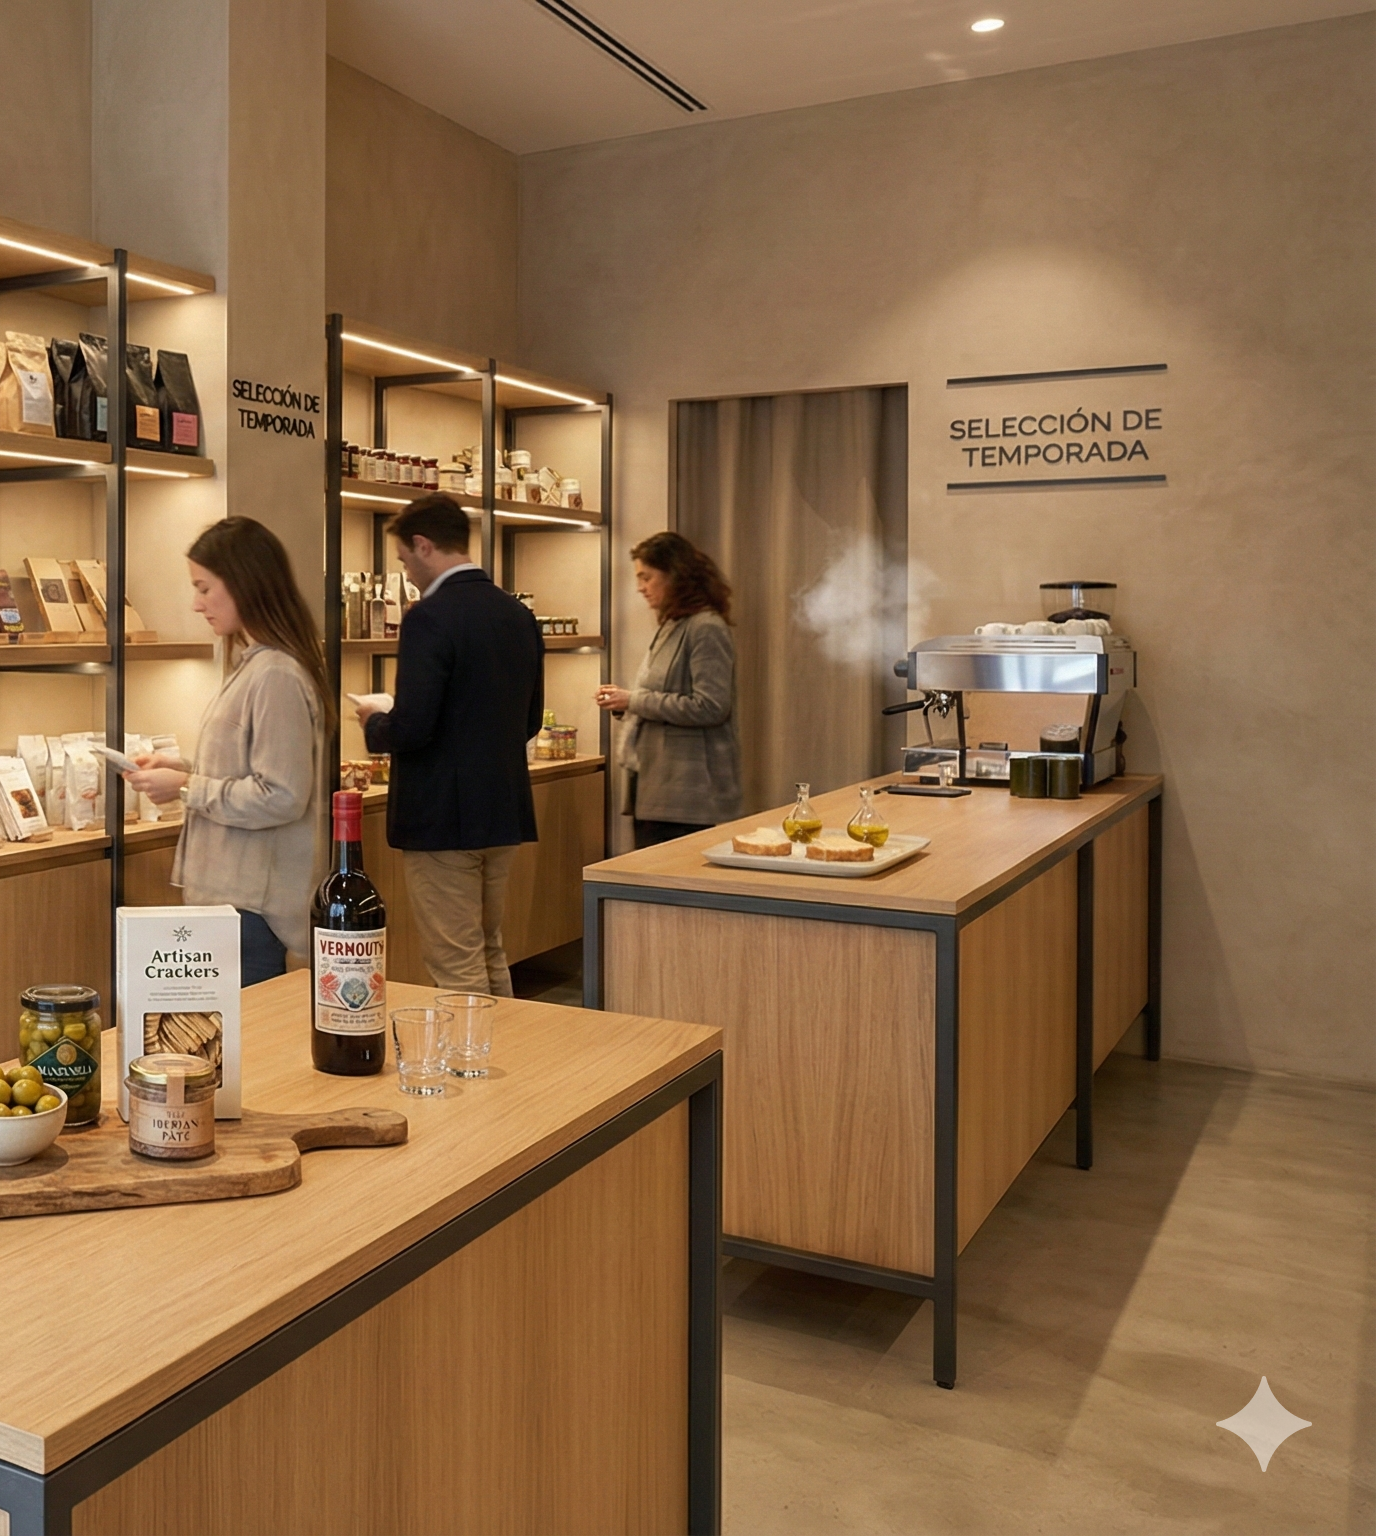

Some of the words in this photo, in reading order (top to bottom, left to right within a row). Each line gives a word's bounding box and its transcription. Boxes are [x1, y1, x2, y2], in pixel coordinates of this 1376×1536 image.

[232, 379, 301, 411] SELECCIÓN
[304, 393, 320, 413] DE
[237, 408, 316, 439] TEMPORADA
[949, 407, 1112, 440] SELECCIÓN
[1122, 408, 1163, 431] DE
[961, 439, 1150, 467] TEMPORADA
[151, 948, 212, 964] Artisan
[144, 964, 220, 979] Crackers
